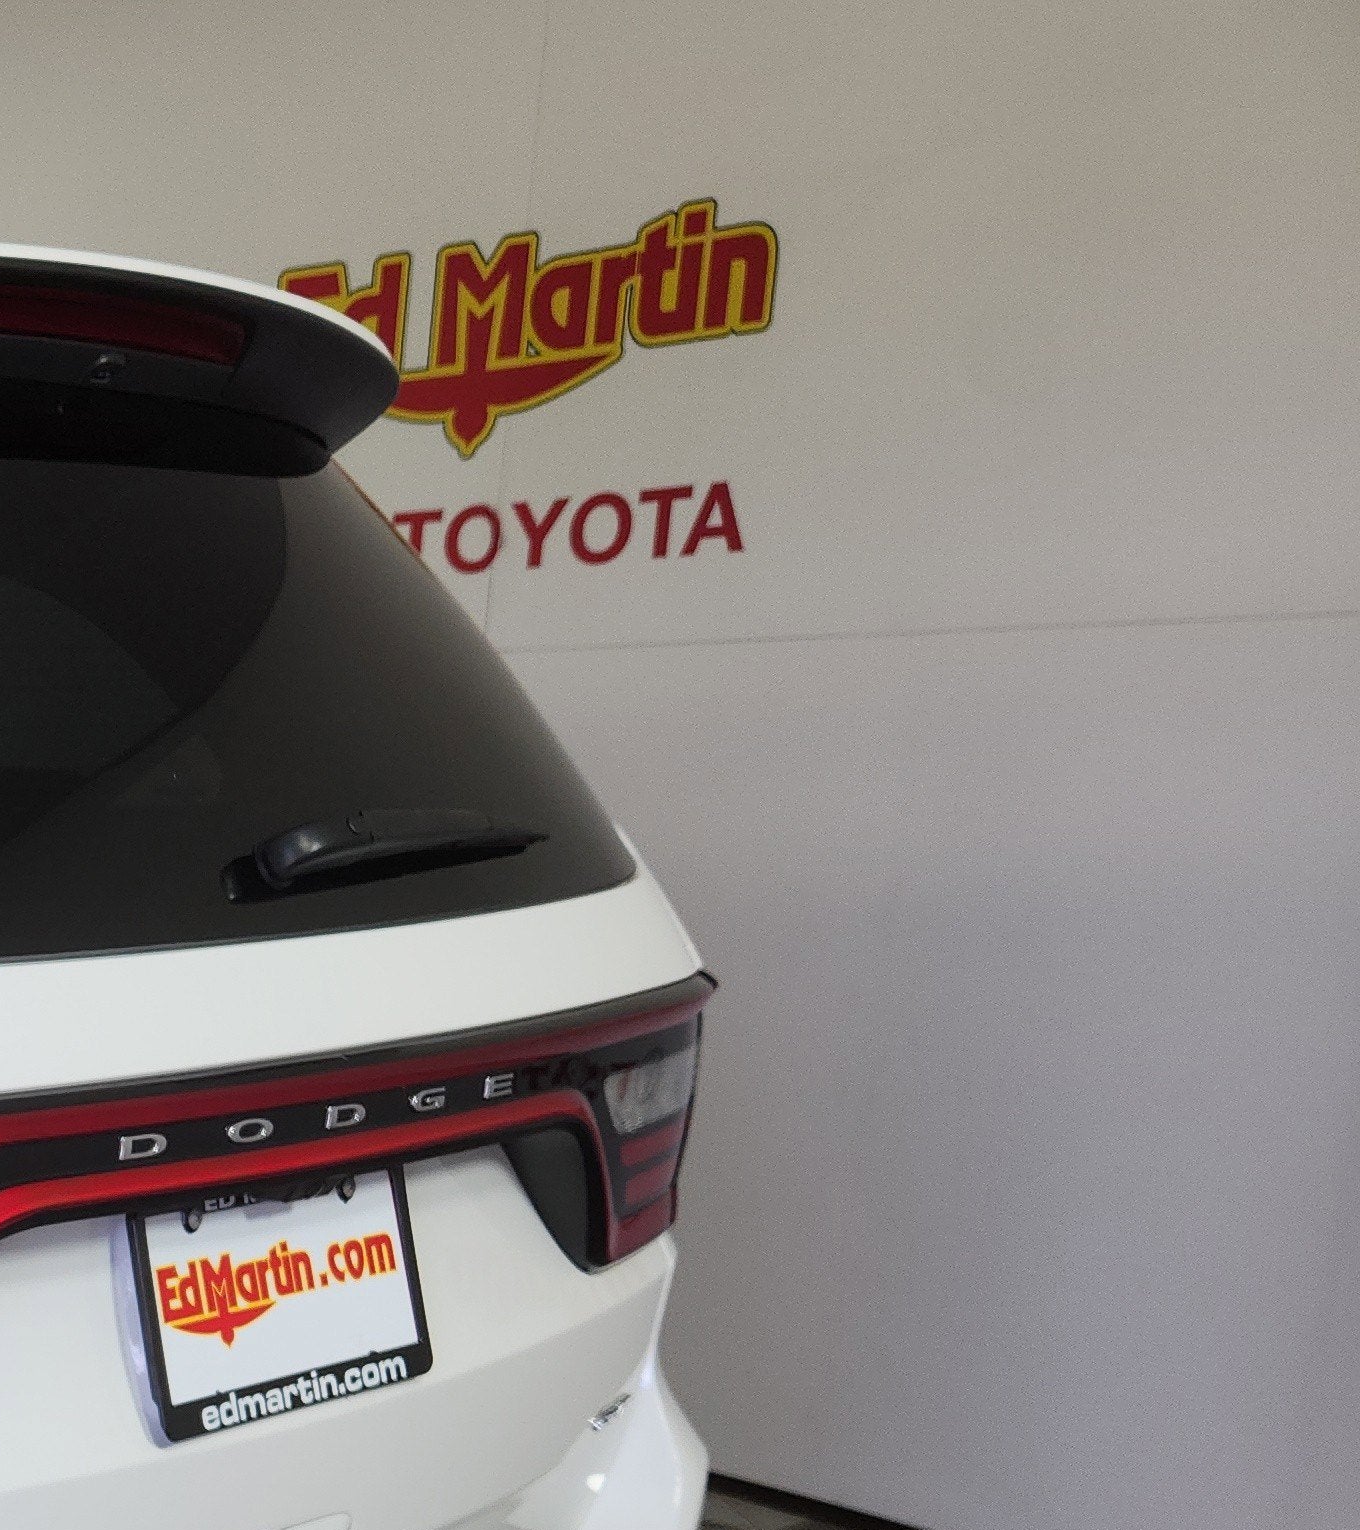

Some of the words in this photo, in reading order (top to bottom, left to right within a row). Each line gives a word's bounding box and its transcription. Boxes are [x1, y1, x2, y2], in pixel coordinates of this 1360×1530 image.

[427, 196, 779, 374] Martin
[392, 479, 744, 575] TOYOTA
[118, 1072, 516, 1161] DODGE
[155, 1230, 398, 1328] EdMartin.com
[201, 1352, 408, 1431] edmartin.com
